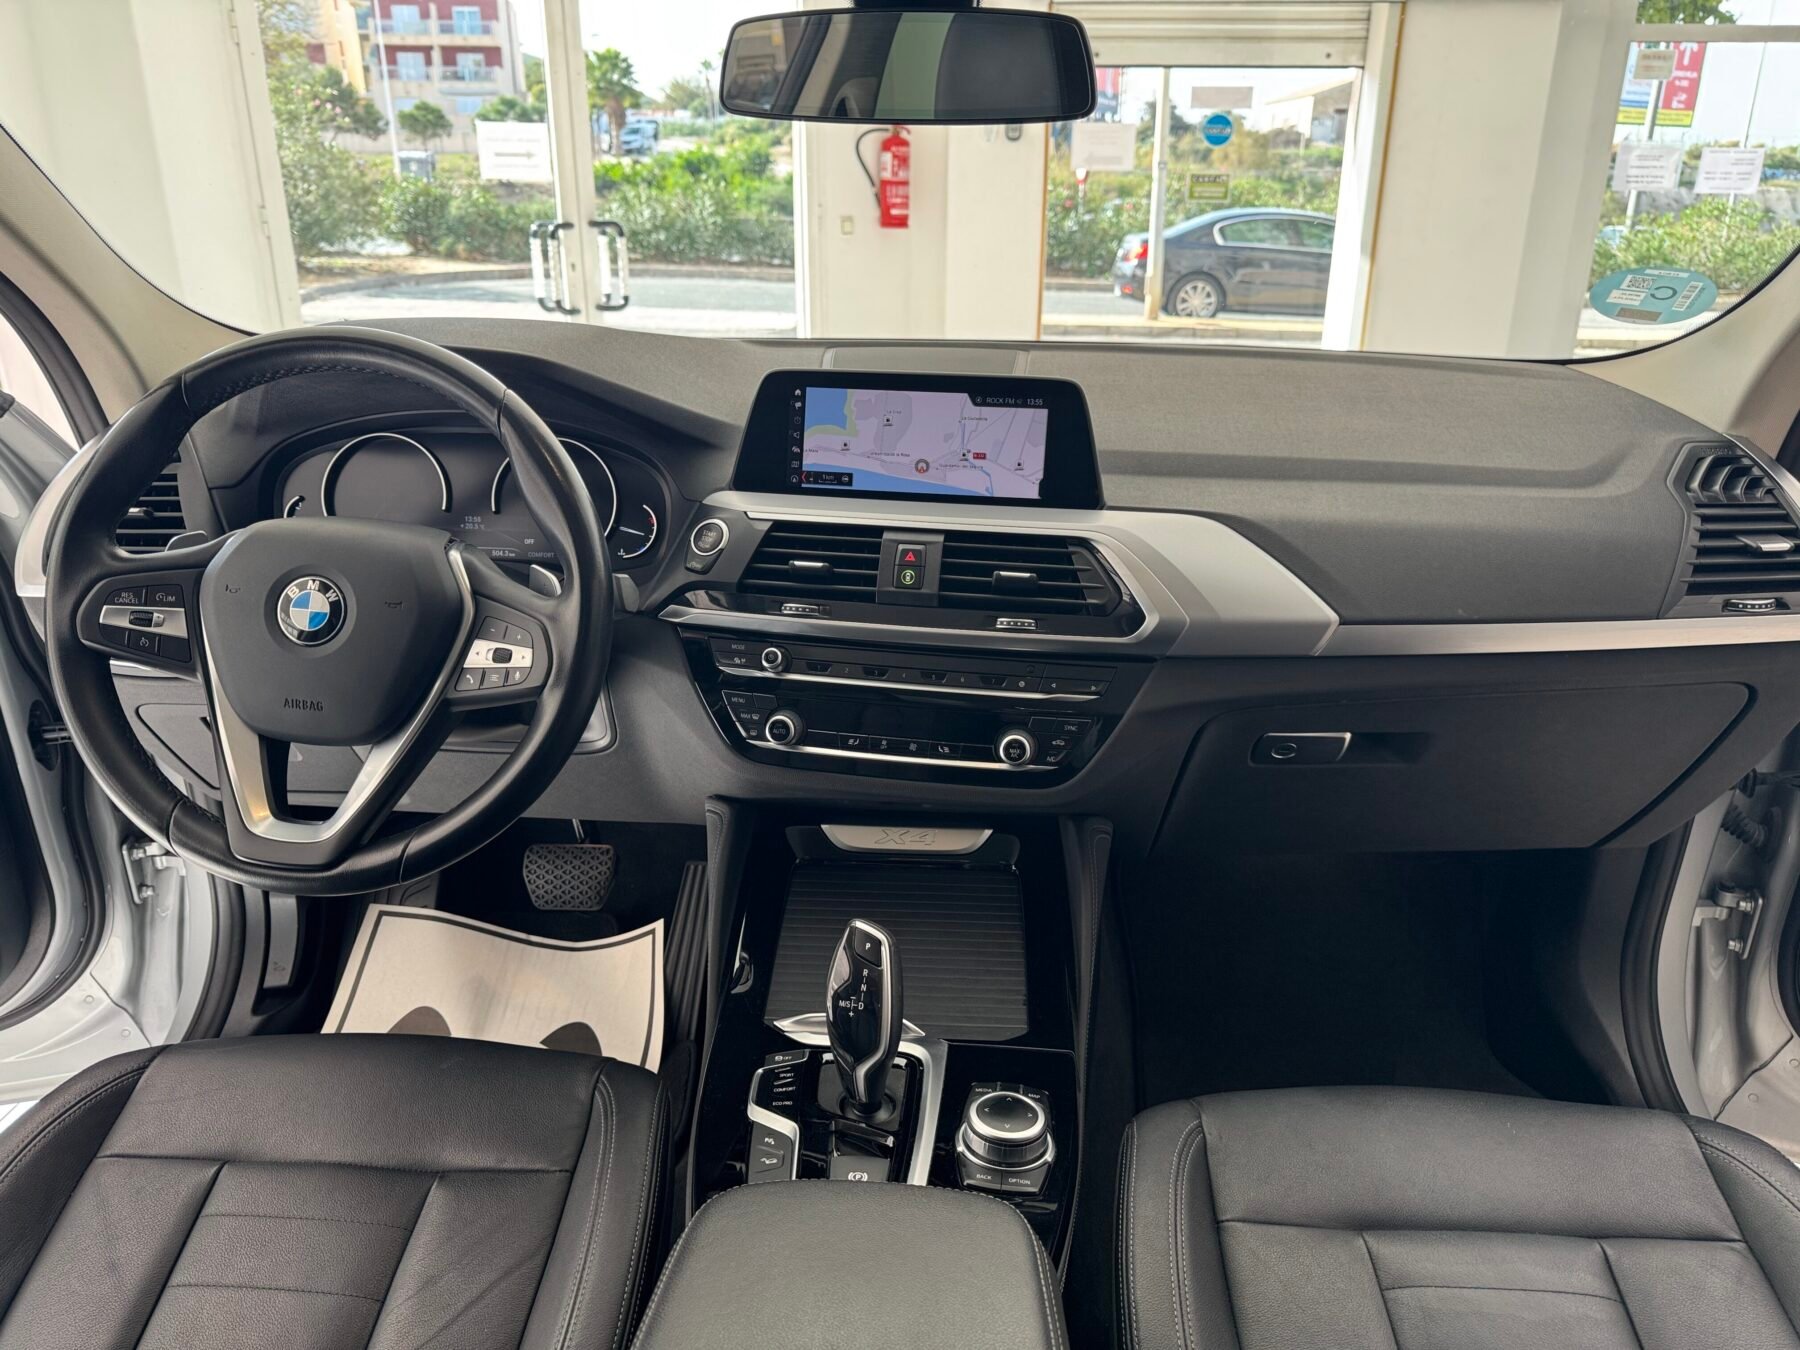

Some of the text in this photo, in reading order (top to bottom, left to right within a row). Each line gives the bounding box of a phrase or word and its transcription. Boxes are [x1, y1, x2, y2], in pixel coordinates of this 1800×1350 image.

[287, 580, 339, 603] BMW
[283, 698, 323, 712] AIRBAG
[874, 828, 938, 846] X4
[862, 969, 868, 977] R
[860, 983, 867, 992] N
[839, 1000, 850, 1008] M/S
